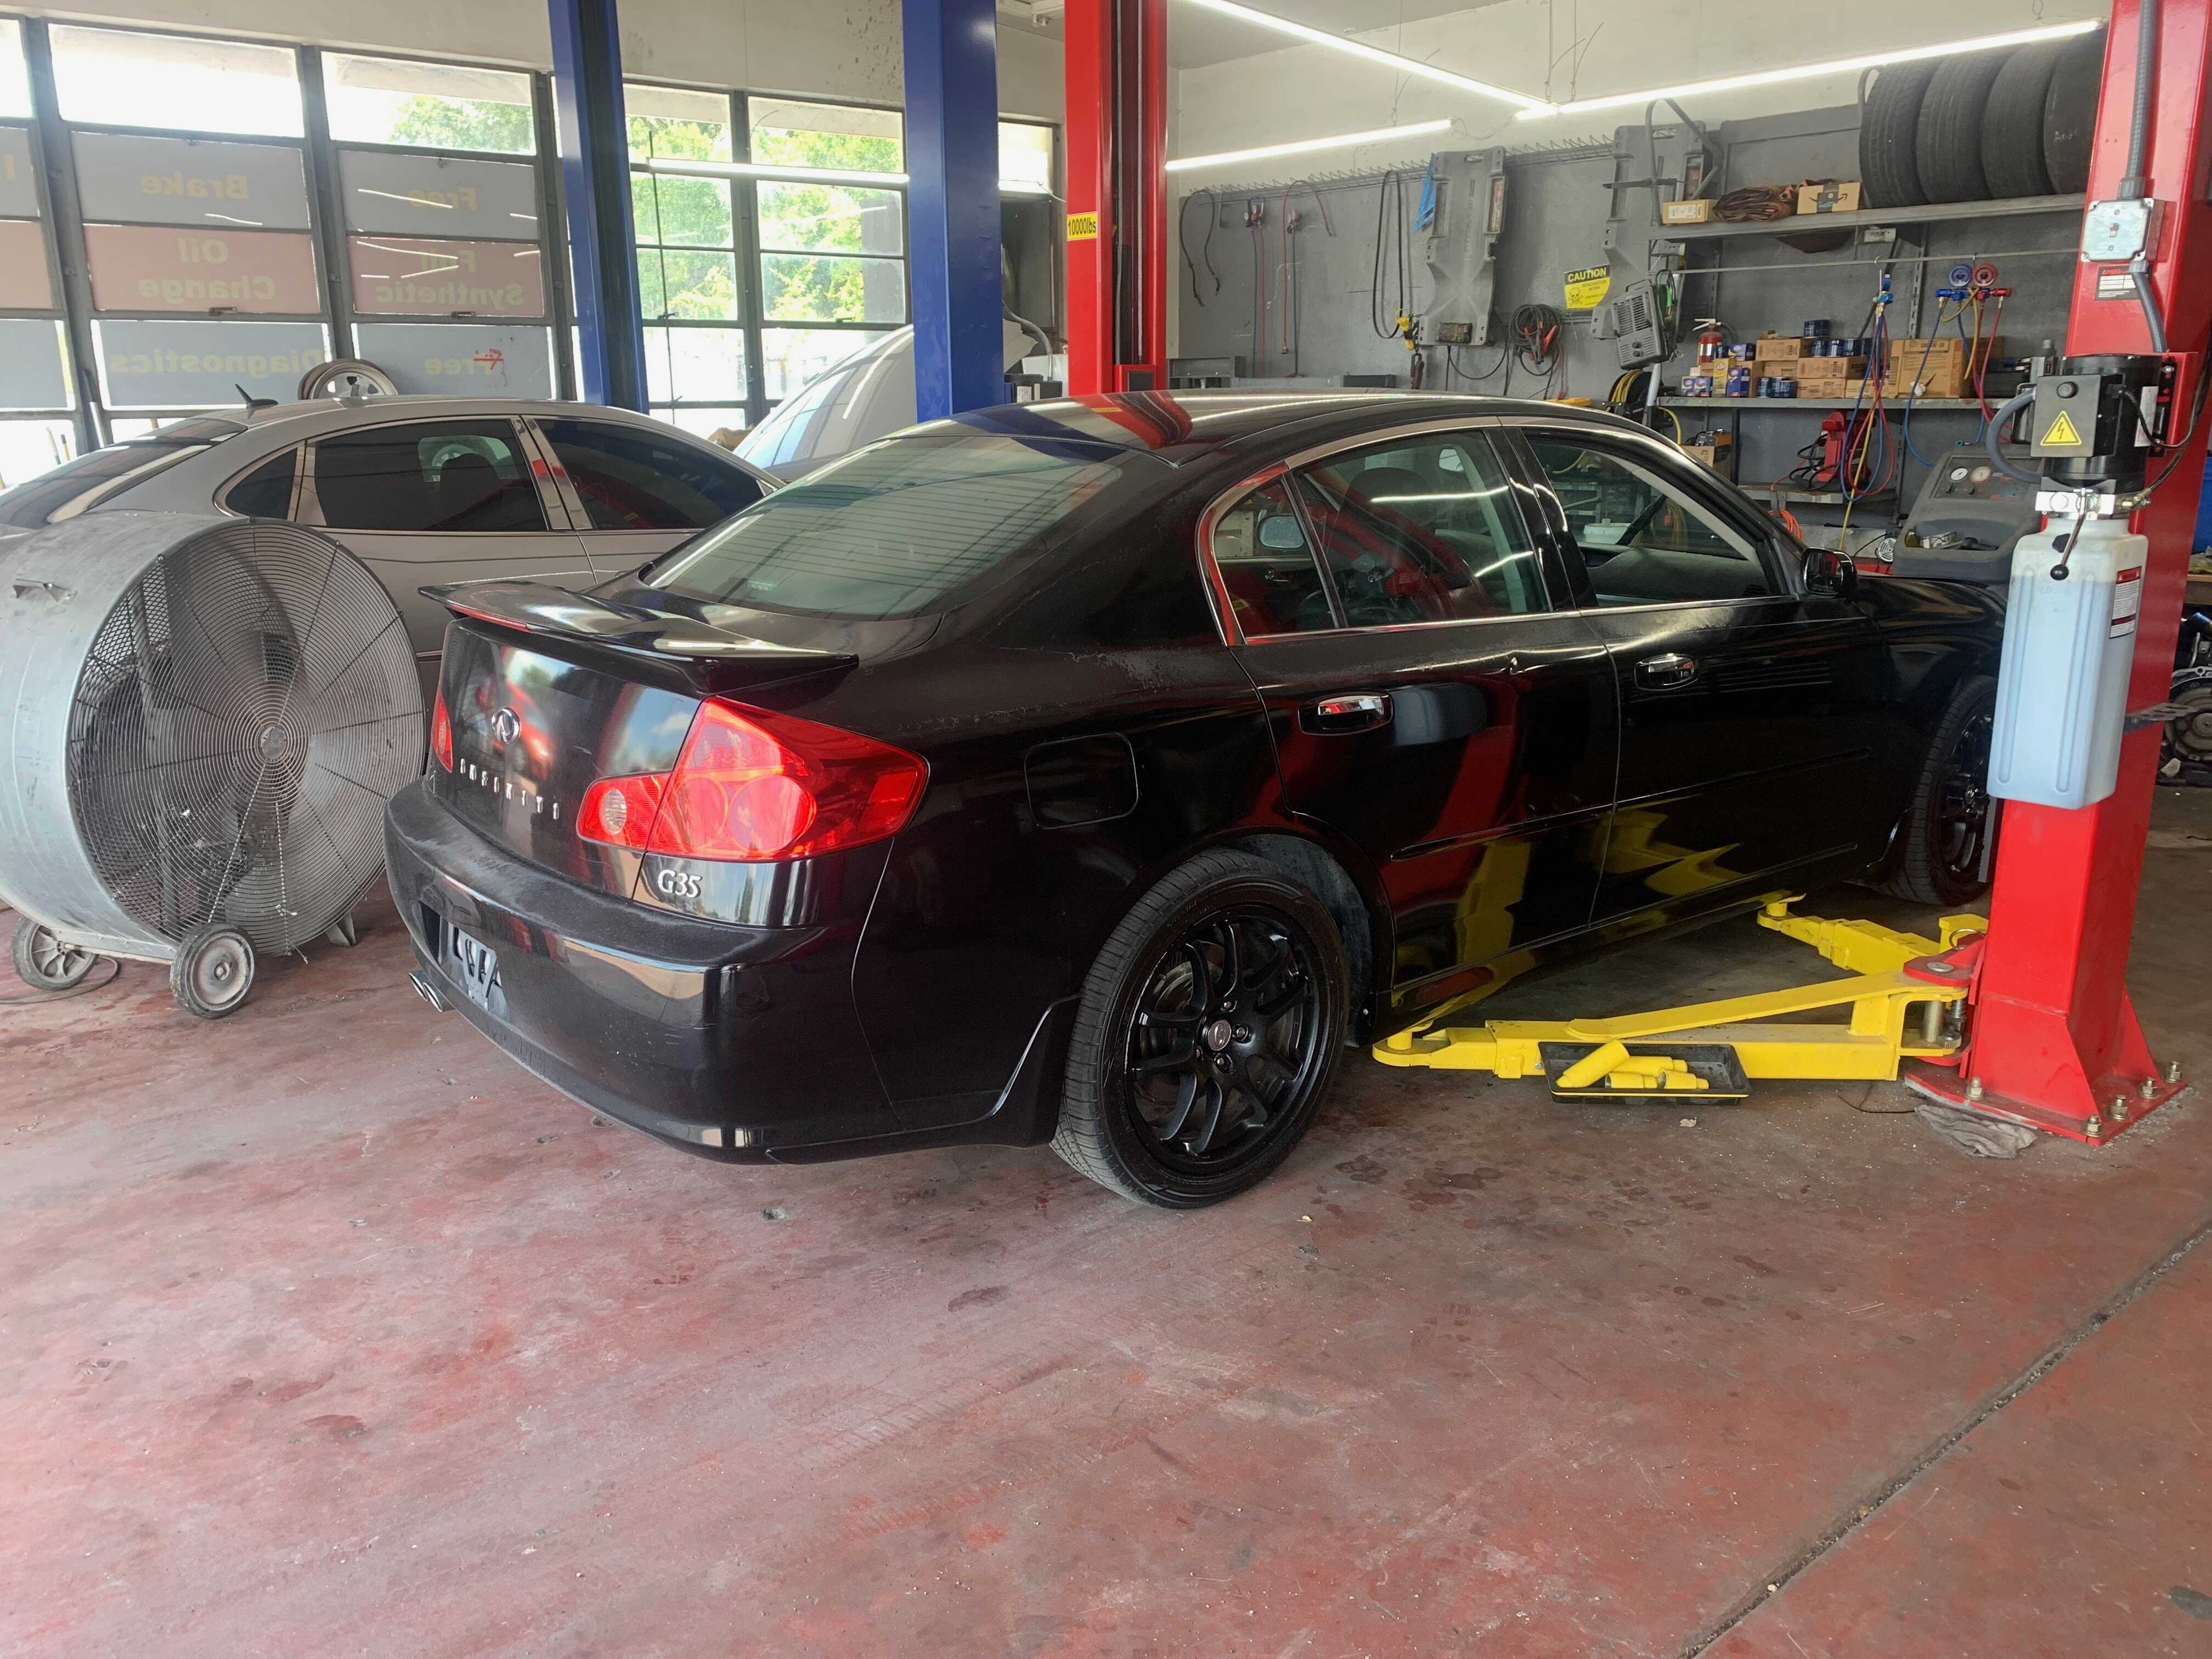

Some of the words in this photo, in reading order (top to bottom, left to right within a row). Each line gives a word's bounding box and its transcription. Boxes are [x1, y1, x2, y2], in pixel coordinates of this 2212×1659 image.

[1068, 217, 1096, 236] 10000lbs
[1568, 267, 1607, 283] CAUTION
[658, 869, 702, 898] G35
